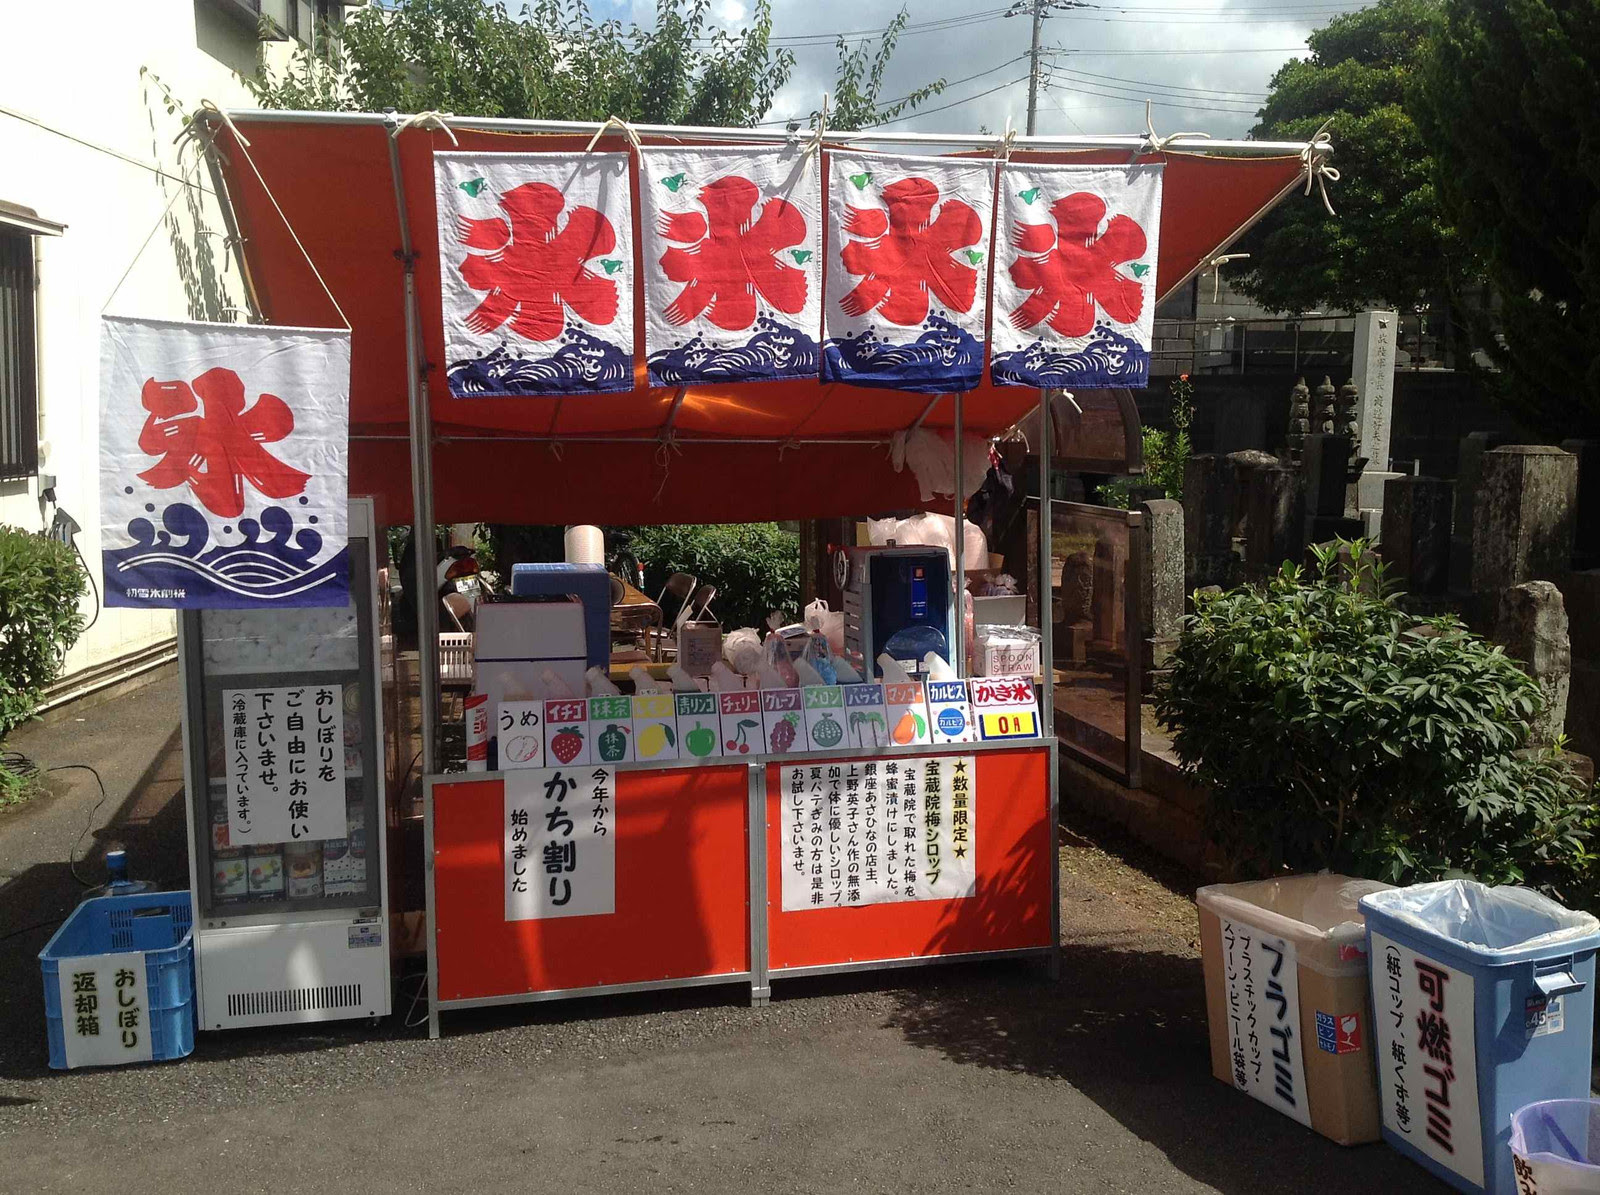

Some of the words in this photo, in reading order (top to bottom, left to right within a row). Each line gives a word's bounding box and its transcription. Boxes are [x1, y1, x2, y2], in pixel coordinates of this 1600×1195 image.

[457, 182, 619, 341] 氷
[657, 176, 808, 331] 氷
[839, 177, 982, 326] 氷
[1008, 191, 1147, 337] 氷
[136, 366, 312, 518] 氷
[723, 695, 758, 713] チェリー
[807, 691, 839, 706] メロン
[848, 692, 881, 705] ハワイ
[930, 684, 965, 700] カルピス
[975, 683, 1032, 702] かき氷
[993, 654, 1032, 663] SPOON
[993, 664, 1032, 673] STRAW
[254, 692, 279, 793] 下さいませ。
[314, 689, 337, 782] おしぼりを
[500, 710, 538, 731] うめ
[548, 703, 584, 721] イチゴ
[592, 699, 628, 717] 抹茶
[604, 733, 622, 757] 抹茶
[940, 718, 964, 726] カルピス
[286, 688, 309, 839] ご自由にお使い
[592, 768, 609, 836] 今年から
[511, 809, 528, 893] 始めました
[542, 771, 577, 906] かち割り
[791, 768, 805, 876] お試し下さいませ。
[810, 767, 824, 905] 夏バテぎみの方は是非
[828, 766, 842, 907] 加で体に優しいシロップ。
[846, 764, 860, 902] 上野英子さん作の無添
[864, 763, 878, 885] 銀座あさひなの店主、
[885, 762, 899, 895] 蜂蜜漬けにしました。
[903, 769, 917, 897] 宝蔵院で取れた梅を
[925, 760, 941, 885] 宝蔵院梅シロップ
[73, 972, 100, 1036] 返却箱
[114, 969, 138, 1048] おしぼり
[1240, 936, 1262, 1083] プラスチックカップ・
[1531, 1011, 1546, 1026] 45
[1414, 958, 1457, 1155] 可燃ゴミ
